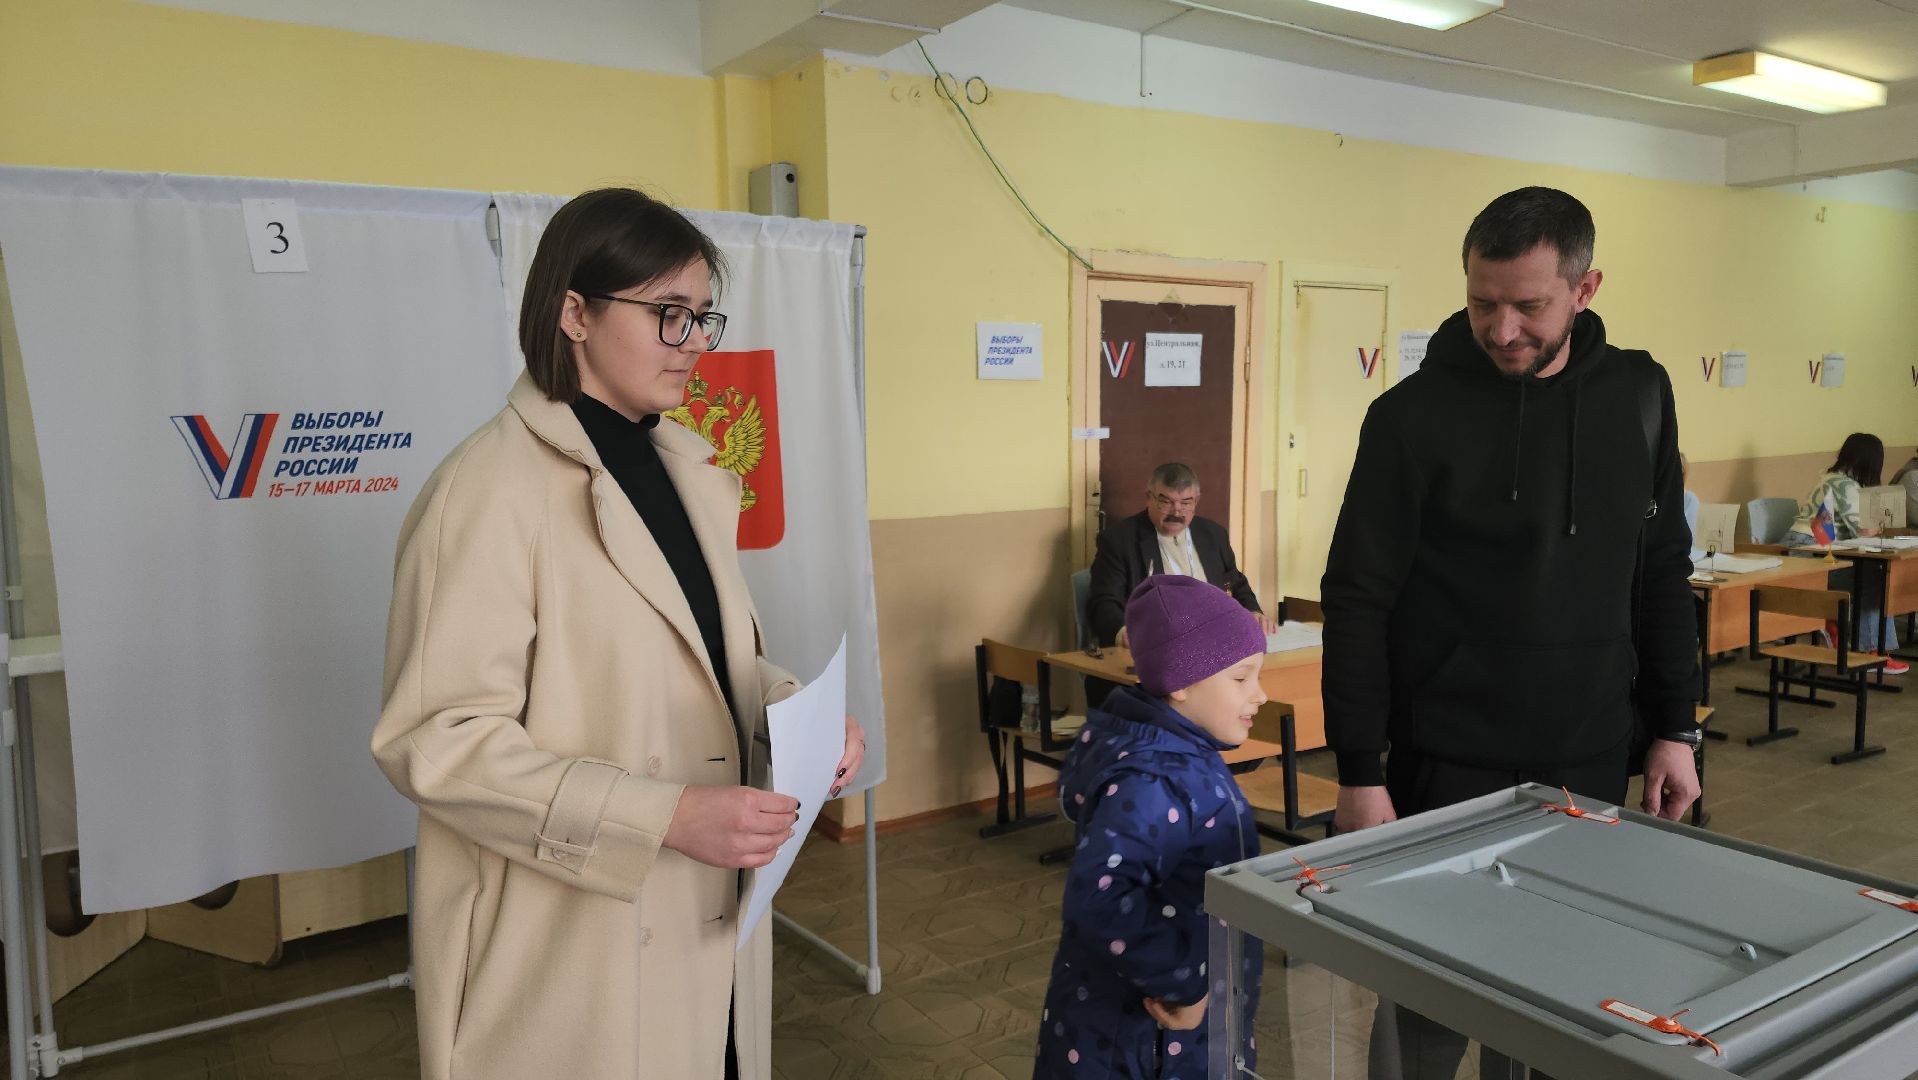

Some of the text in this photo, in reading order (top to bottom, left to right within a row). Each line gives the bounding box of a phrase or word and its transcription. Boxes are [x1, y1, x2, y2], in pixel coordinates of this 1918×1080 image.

[266, 221, 289, 255] 3
[990, 335, 1024, 344] ВЫБОРЫ
[987, 346, 1033, 355] ПРЕЗИДЕНТА
[984, 357, 1015, 366] РОССИИ
[290, 410, 384, 430] ВЫБОРЫ
[282, 432, 412, 454] ПРЕЗИДЕНТА
[273, 457, 359, 478] РОССИИ
[312, 479, 361, 496] МАРТА
[364, 476, 399, 493] 2024
